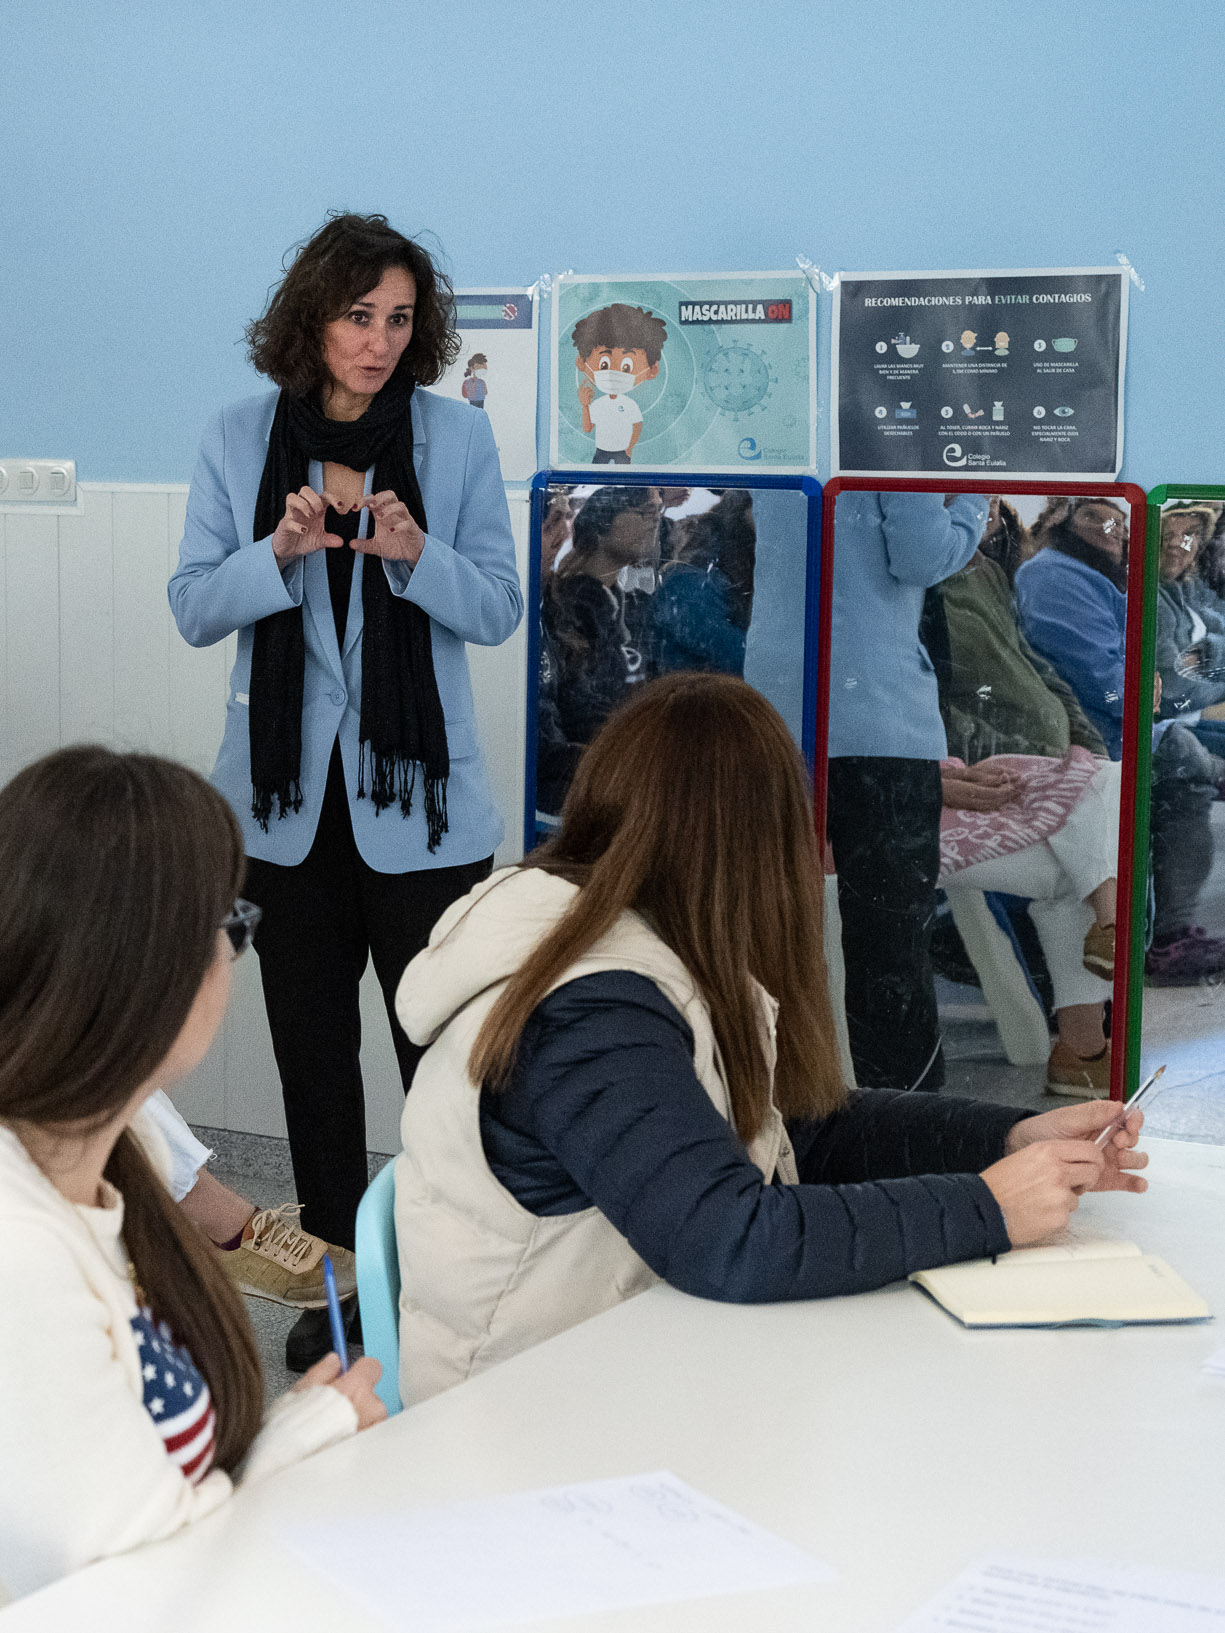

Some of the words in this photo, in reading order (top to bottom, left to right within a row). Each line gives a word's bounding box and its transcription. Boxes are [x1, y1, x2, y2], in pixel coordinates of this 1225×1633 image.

[864, 295, 962, 308] RECOMENDACIONES
[965, 295, 992, 305] PARA
[994, 294, 1030, 304] EVITAR
[1032, 292, 1092, 304] CONTAGIOS
[680, 303, 766, 322] MASCARILLA
[767, 303, 790, 320] ON
[967, 453, 991, 461] Colegio
